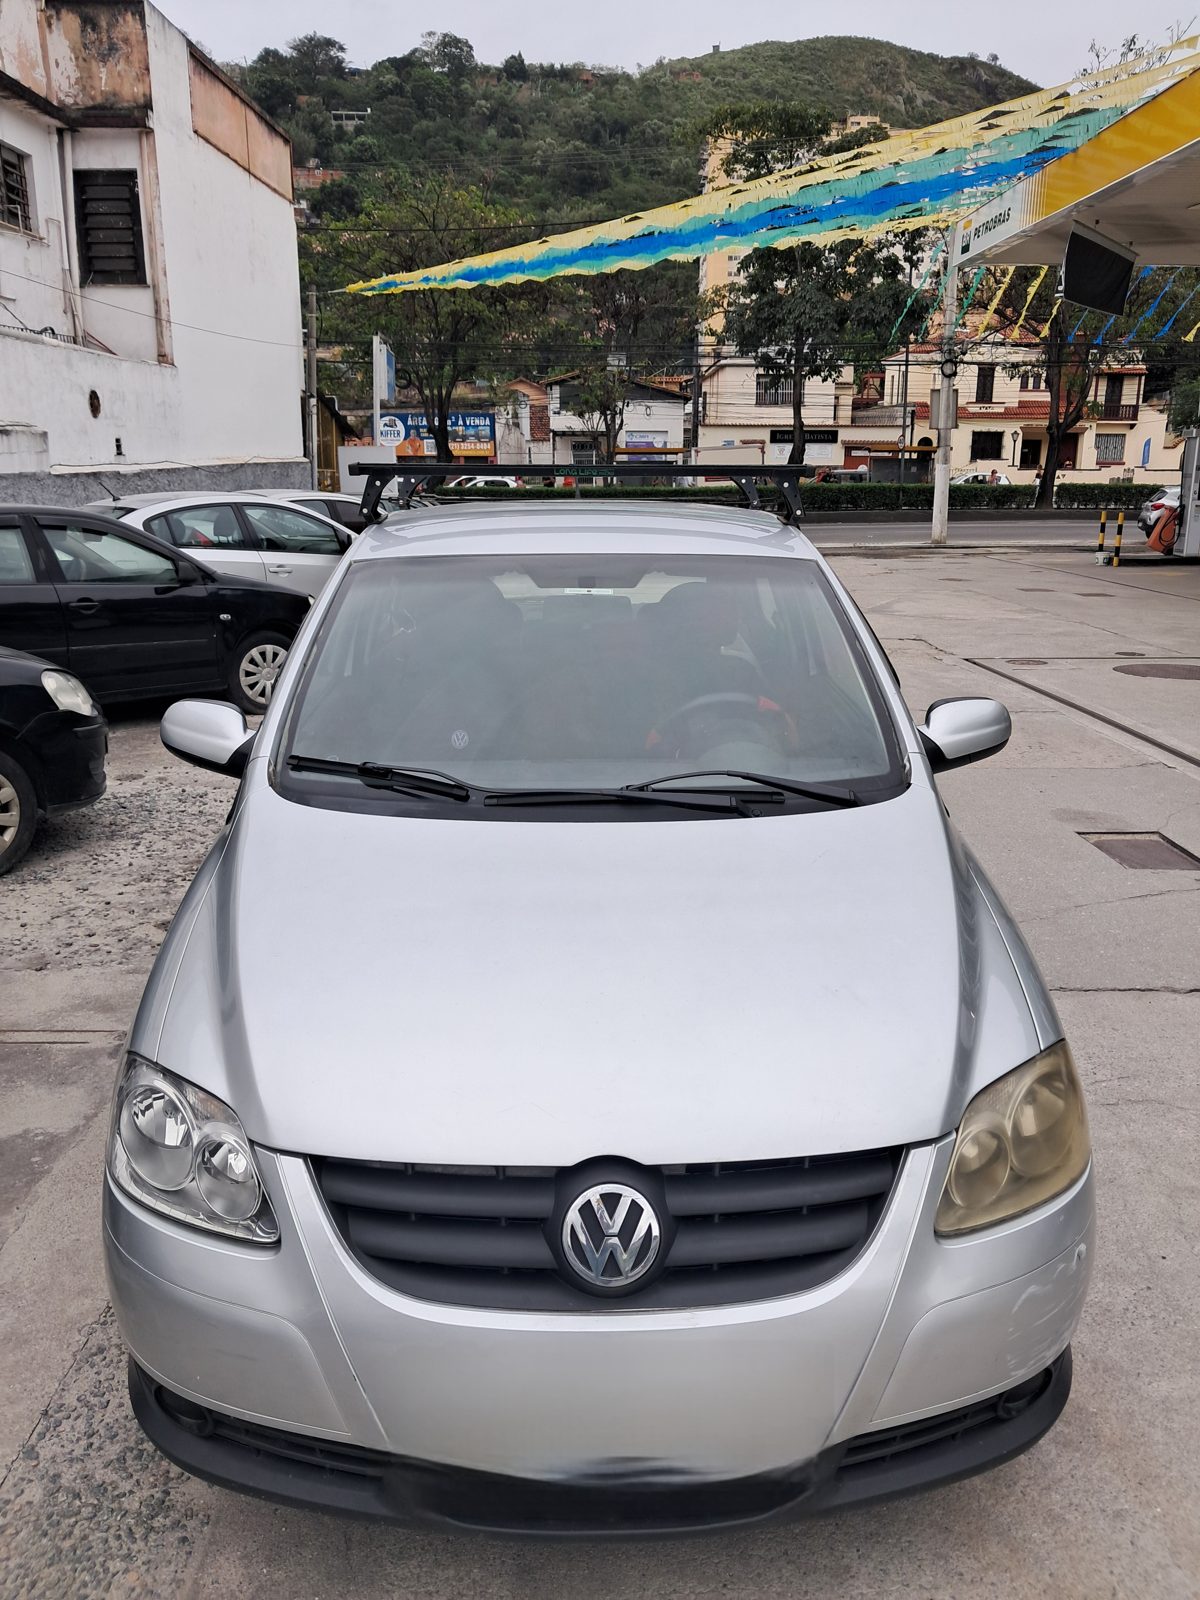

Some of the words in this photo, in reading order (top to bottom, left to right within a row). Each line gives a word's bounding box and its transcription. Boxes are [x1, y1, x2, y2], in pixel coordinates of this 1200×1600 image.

[973, 207, 1011, 241] PETROBRAS
[407, 415, 427, 426] ÁREA
[466, 416, 491, 426] VENDA
[380, 430, 401, 438] KIFFER
[776, 432, 793, 440] IGRE
[804, 432, 832, 441] BATISTA
[563, 1185, 659, 1286] VW
